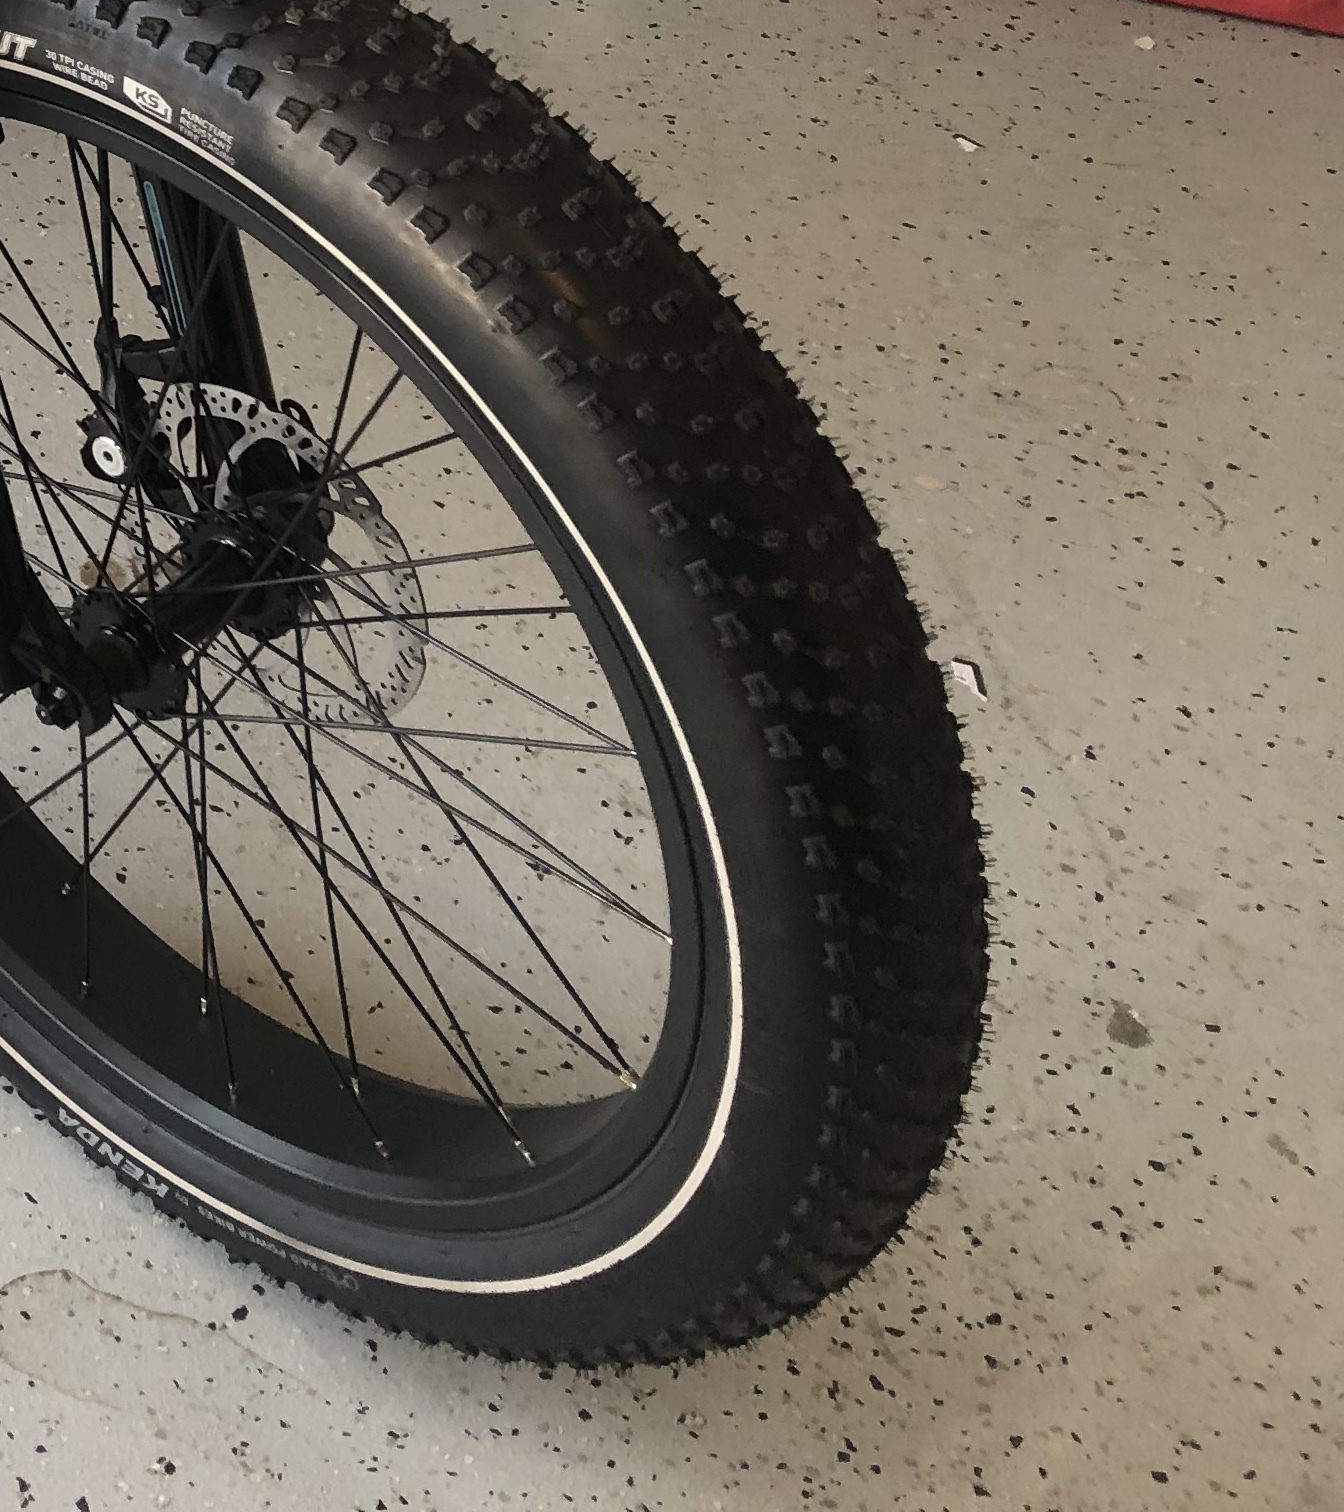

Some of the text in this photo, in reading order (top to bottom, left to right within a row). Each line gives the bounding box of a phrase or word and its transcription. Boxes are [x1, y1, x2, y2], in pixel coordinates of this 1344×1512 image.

[45, 49, 115, 84] 30 TPI CASING
[52, 61, 109, 91] WIRE BEAD
[135, 87, 160, 109] KS
[179, 116, 232, 153] RESISTANT
[180, 107, 234, 145] PUNCTURE
[179, 125, 236, 166] TIRE CASING
[57, 1106, 169, 1198] KENDA
